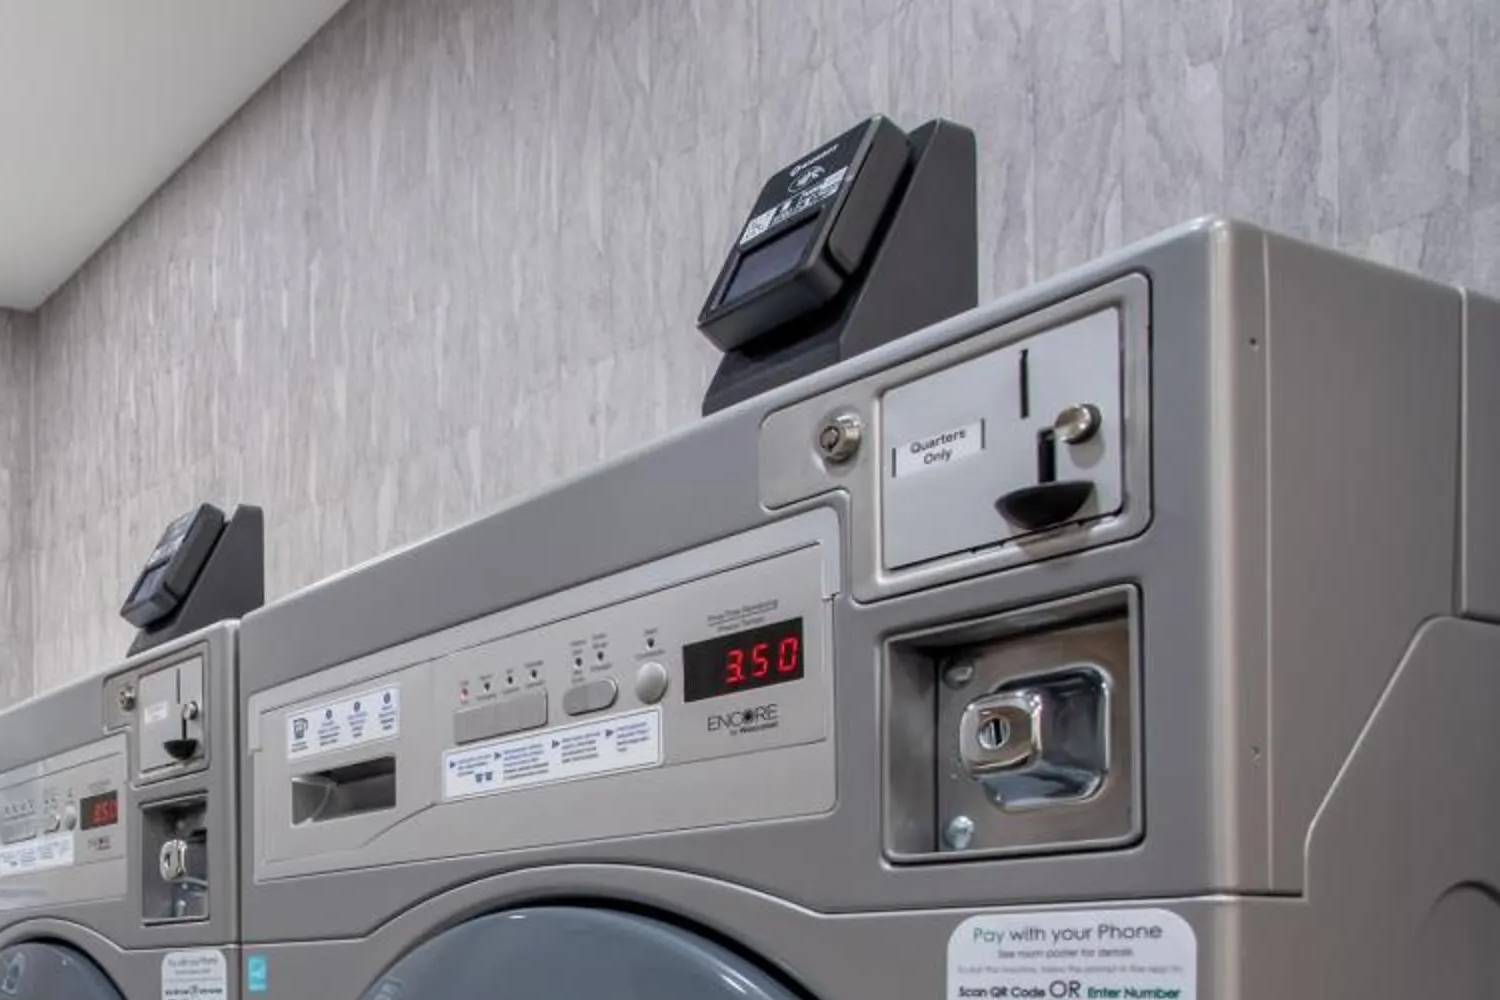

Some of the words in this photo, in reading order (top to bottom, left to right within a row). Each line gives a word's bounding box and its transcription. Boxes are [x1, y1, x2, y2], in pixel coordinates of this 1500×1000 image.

[910, 429, 966, 454] Quarters
[924, 448, 953, 464] Only
[973, 927, 1005, 946] Pay
[1010, 926, 1046, 943] with
[1051, 927, 1093, 946] your
[1097, 923, 1163, 940] Phone
[958, 986, 987, 998] Scan
[989, 986, 1008, 998] QR
[1010, 986, 1046, 998] Code
[1049, 980, 1082, 998] OR
[1087, 987, 1121, 999] Enter
[1124, 987, 1181, 999] Number
